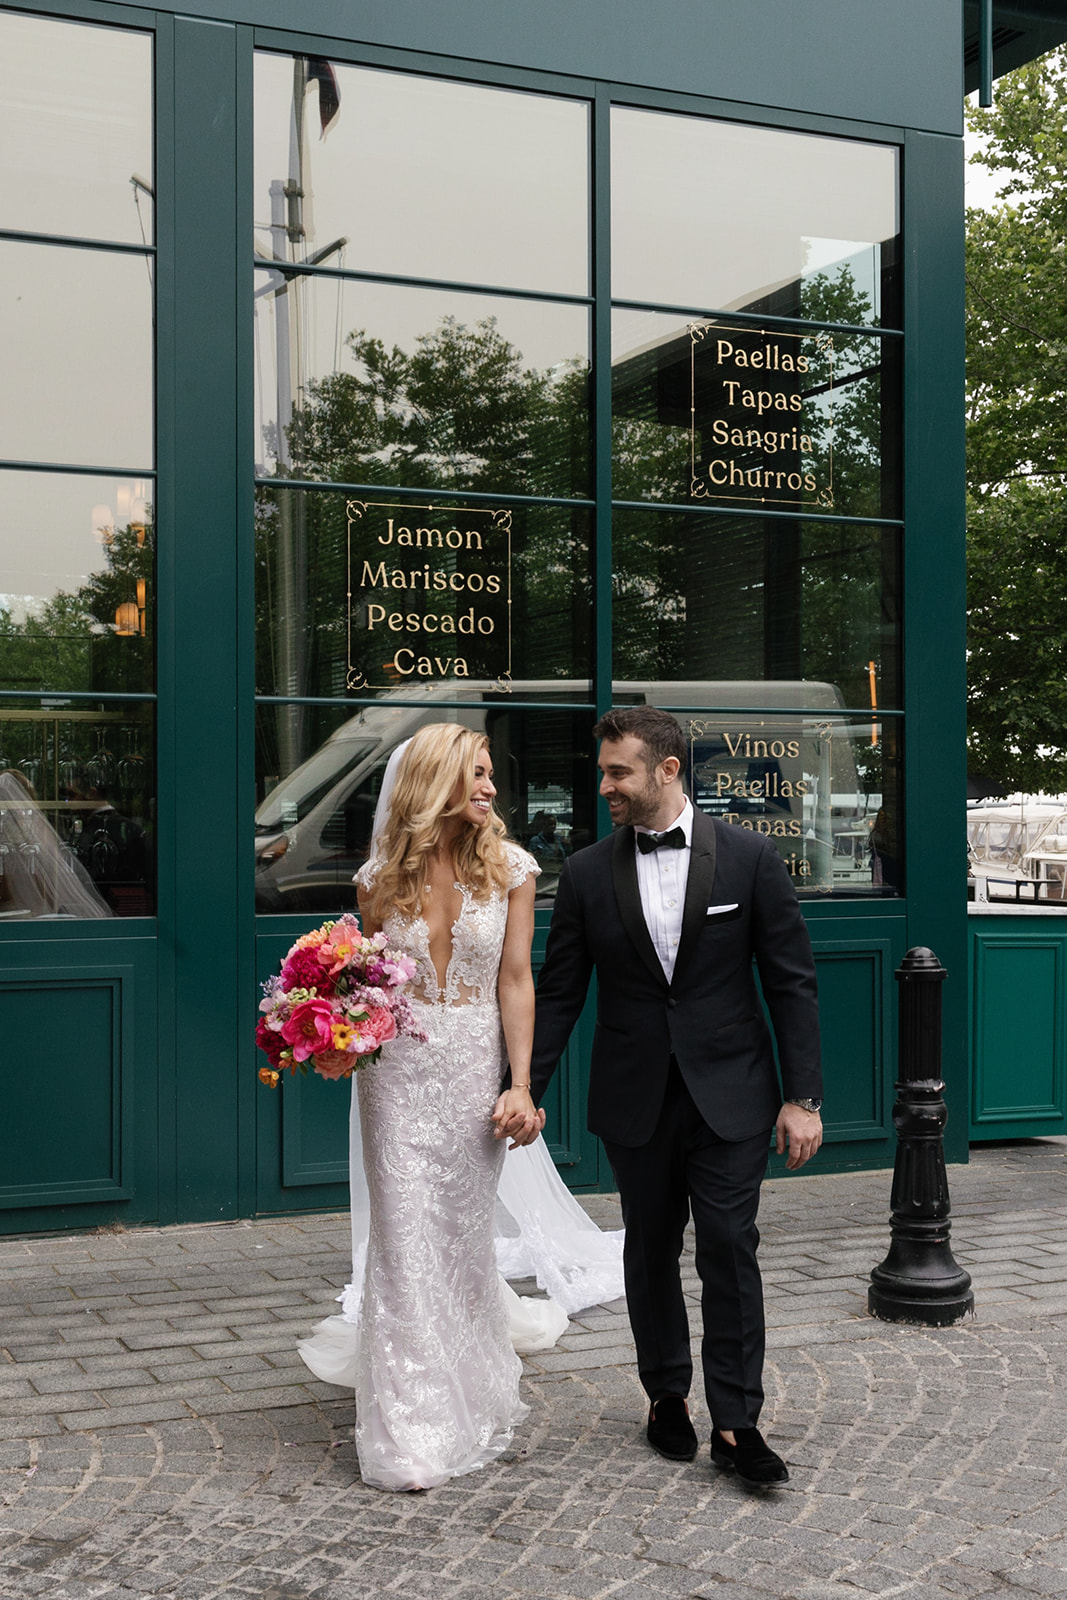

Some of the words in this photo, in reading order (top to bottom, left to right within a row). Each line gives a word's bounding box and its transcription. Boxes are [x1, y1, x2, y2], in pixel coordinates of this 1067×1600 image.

[716, 339, 809, 373] Paellas
[722, 380, 802, 415] Tapas
[711, 419, 813, 454] Sangria
[708, 459, 817, 491] Churros
[360, 560, 501, 594] Mariscos
[367, 603, 495, 635] Pescado
[393, 648, 470, 677] Cava
[723, 732, 800, 758] Vinos
[716, 772, 808, 798] Paellas
